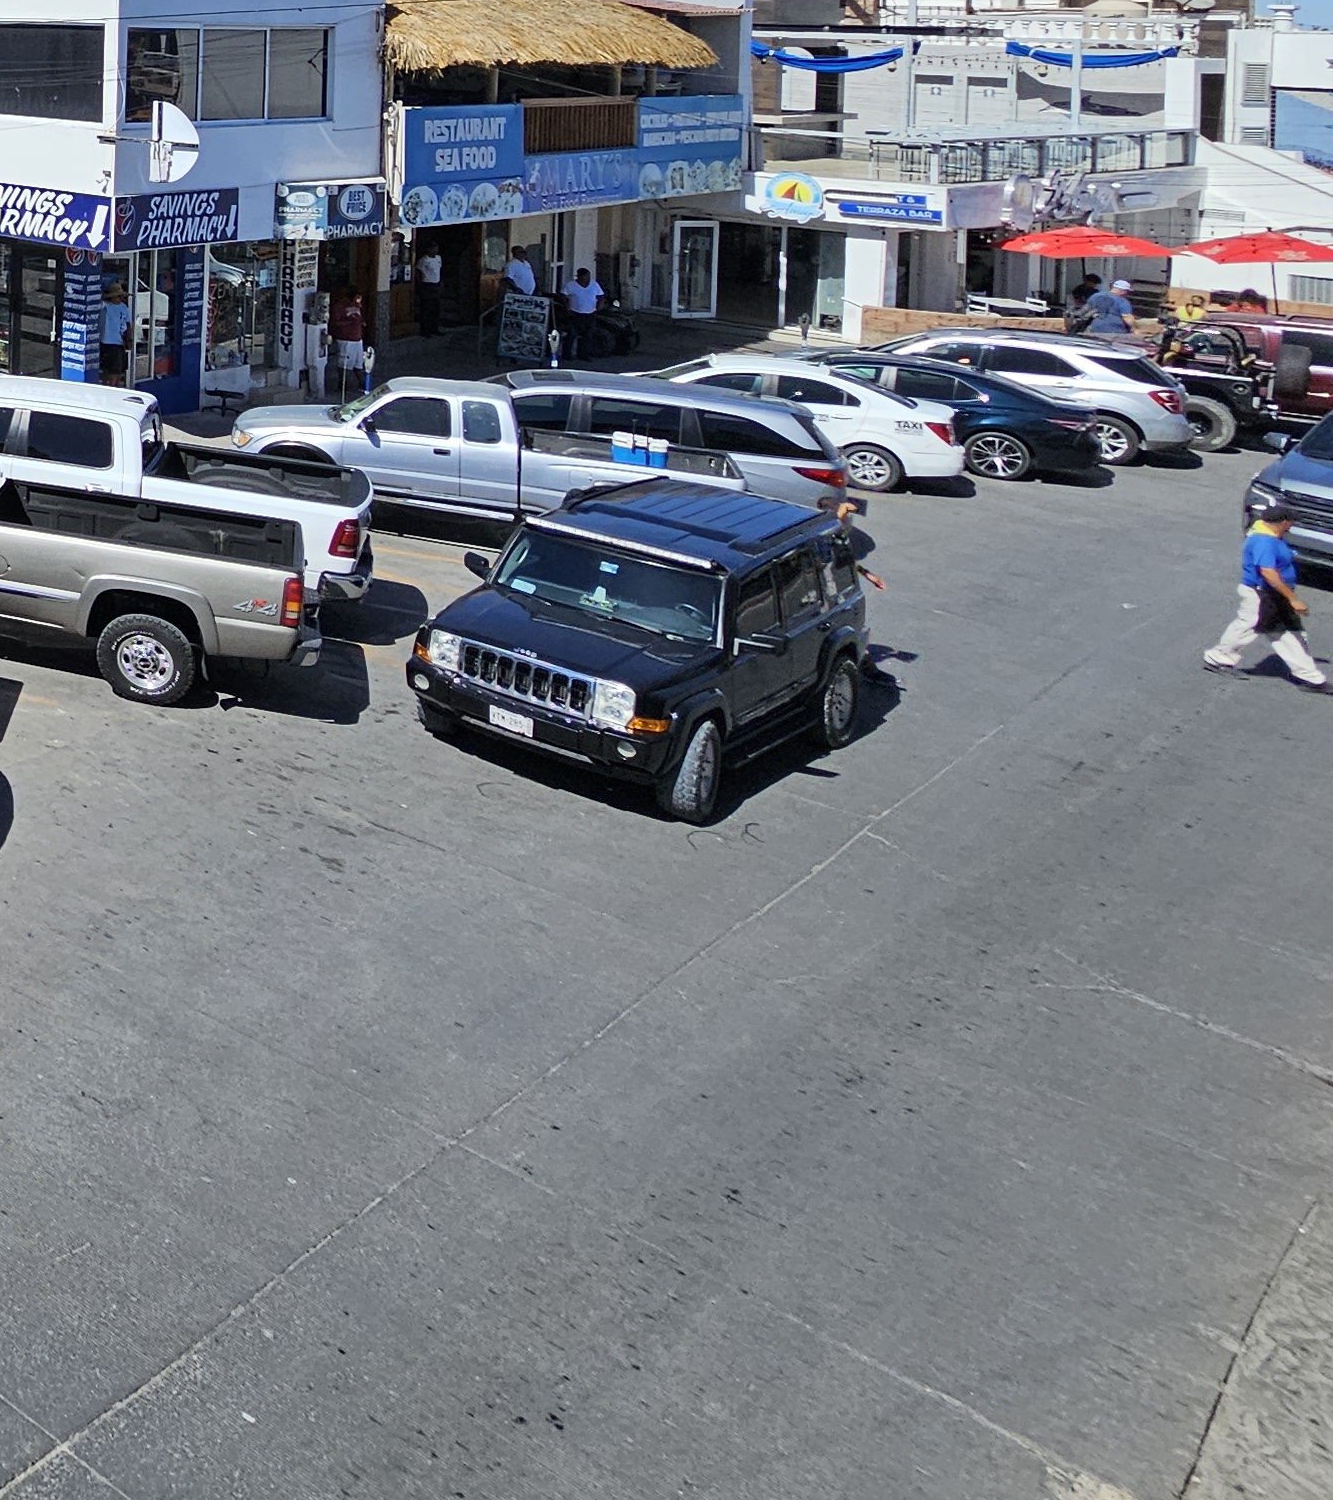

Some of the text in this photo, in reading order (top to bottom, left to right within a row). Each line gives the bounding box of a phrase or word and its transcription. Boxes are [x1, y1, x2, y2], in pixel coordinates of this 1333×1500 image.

[423, 116, 507, 144] RESTAURANT
[434, 145, 497, 173] SEA FOOD
[540, 153, 623, 197] MARY'S
[148, 192, 220, 220] SAVINGS
[346, 201, 367, 214] PRICE
[348, 190, 366, 202] BEST
[278, 206, 324, 214] PHARMACY
[855, 204, 933, 219] TERRAZA BAR
[136, 214, 227, 248] PHARMACY
[327, 220, 384, 239] PHARMACY
[279, 239, 295, 352] PHARMACY
[894, 420, 923, 430] TAXI
